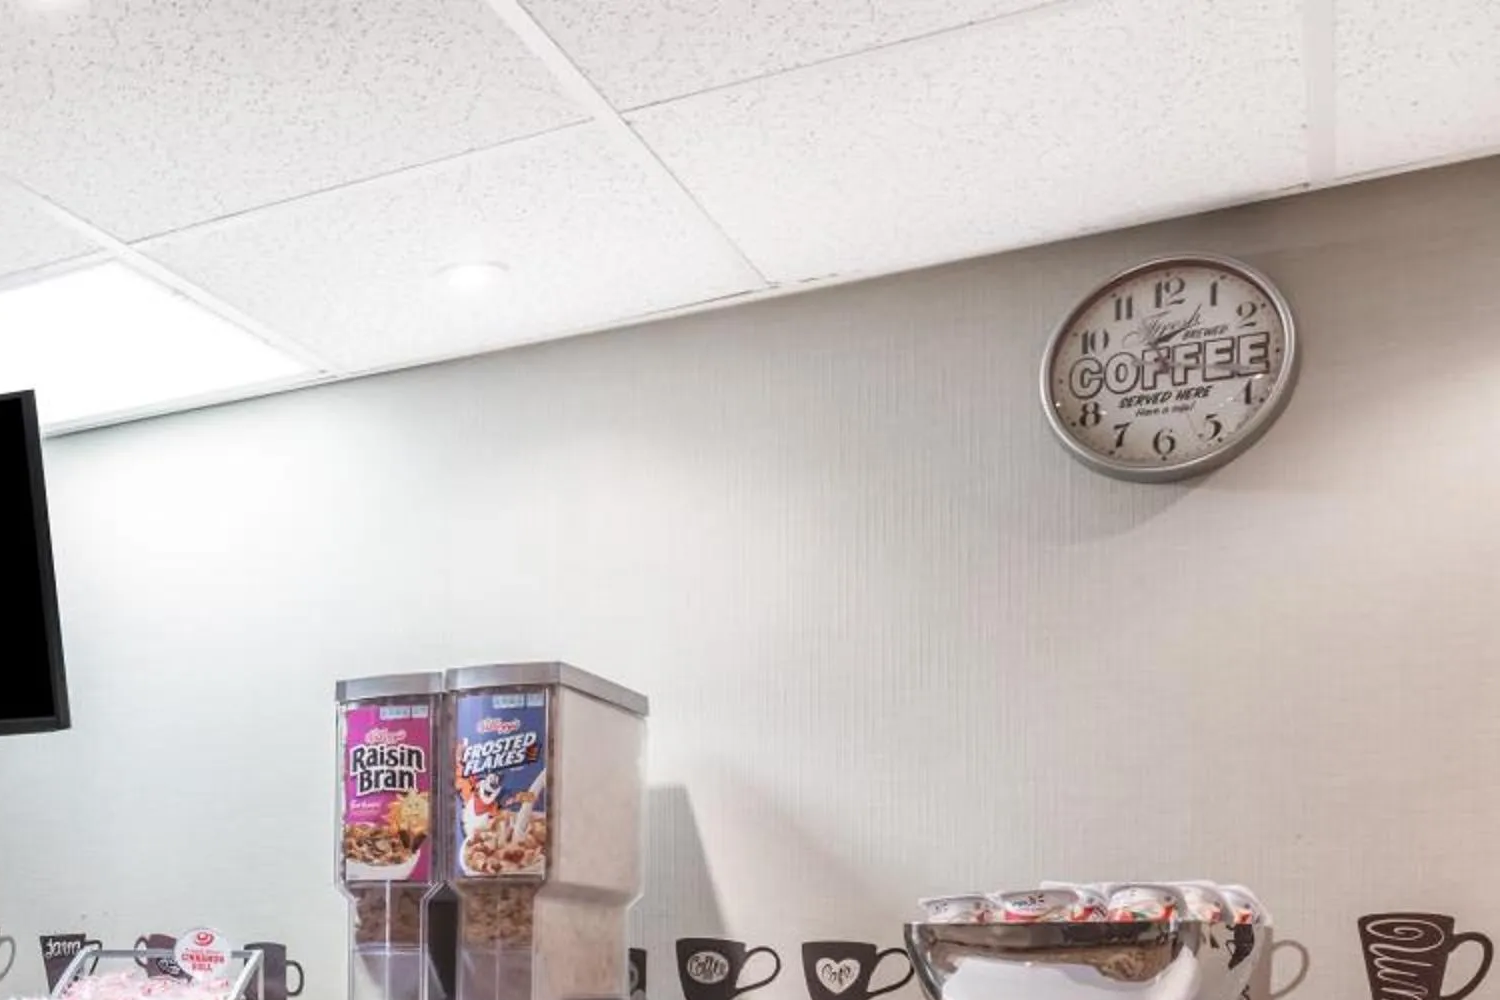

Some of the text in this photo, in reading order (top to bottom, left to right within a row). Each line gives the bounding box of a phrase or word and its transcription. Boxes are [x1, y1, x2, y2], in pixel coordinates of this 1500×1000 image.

[1154, 277, 1186, 308] 12
[1209, 281, 1219, 306] 1
[1114, 296, 1133, 321] 11
[1237, 301, 1258, 328] 2
[1081, 330, 1109, 354] 10
[1068, 332, 1270, 400] COFFEE
[1117, 384, 1213, 409] SERVED HERE
[1078, 402, 1101, 428] 8
[1205, 413, 1222, 441] 5
[1113, 422, 1131, 448] 7
[1152, 428, 1177, 456] 6
[352, 745, 424, 774] Raisin
[463, 732, 536, 763] FROSTED
[463, 750, 525, 777] FLAKES
[359, 768, 416, 793] Bran
